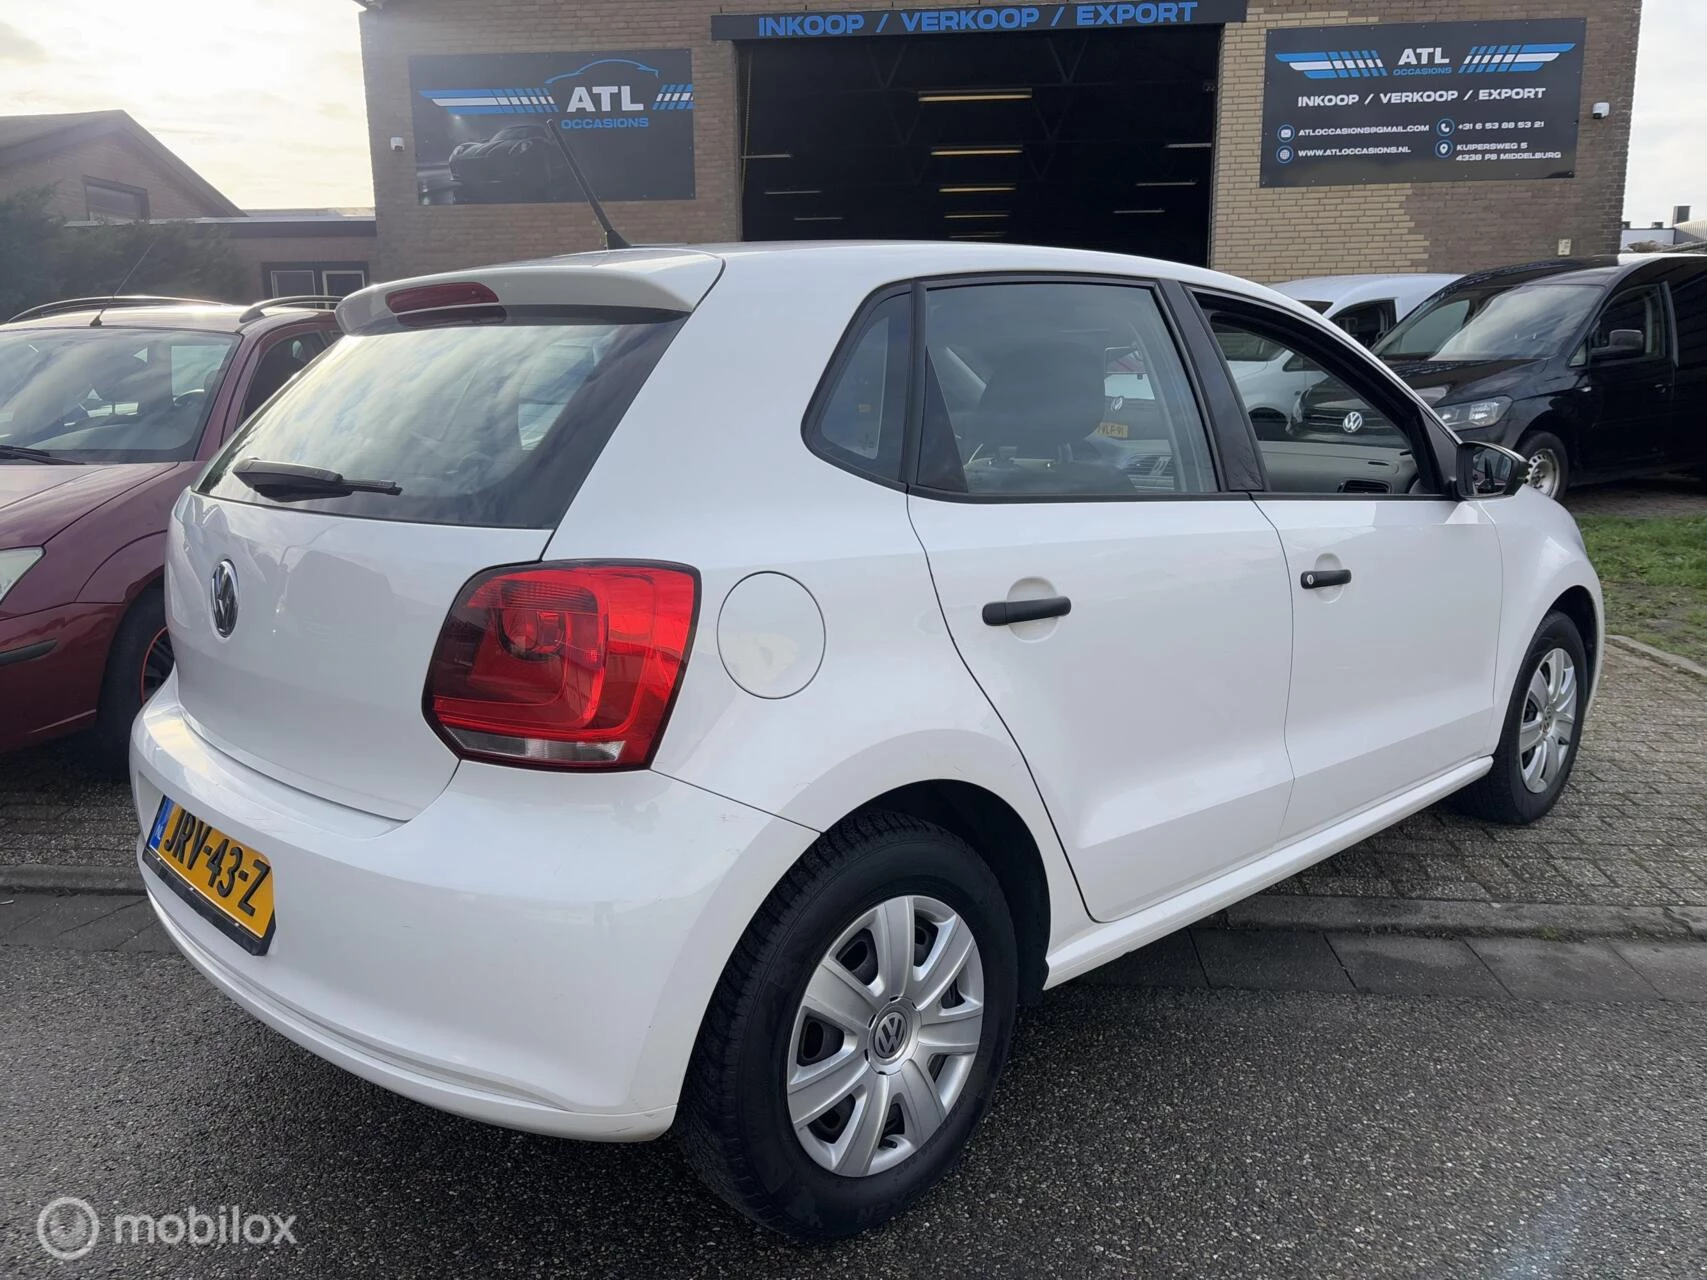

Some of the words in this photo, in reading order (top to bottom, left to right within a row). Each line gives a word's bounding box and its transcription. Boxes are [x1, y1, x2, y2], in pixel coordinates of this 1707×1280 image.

[758, 15, 865, 37] INKOOP
[875, 13, 889, 33] /
[900, 7, 1040, 32] VERKOOP
[1050, 6, 1065, 27] /
[1076, 1, 1198, 26] EXPORT
[1397, 47, 1450, 65] ATL
[1392, 66, 1452, 76] OCCASIONS
[566, 85, 644, 112] ATL
[1297, 94, 1360, 107] INKOOP
[1364, 93, 1375, 105] /
[1379, 90, 1458, 104] VERKOOP
[1463, 89, 1473, 101] /
[1478, 87, 1546, 101] EXPORT
[560, 117, 649, 129] OCCASIONS
[1533, 120, 1545, 128] 21
[1298, 124, 1430, 137] ATLOCCASIONS@GMAIL.COM
[1298, 145, 1411, 157] WWW.ATLOCCASIONS.NL
[1456, 142, 1518, 151] KUIPERSWEG
[1500, 151, 1562, 160] MIDDELBURG
[164, 807, 272, 917] JRV-43-Z
